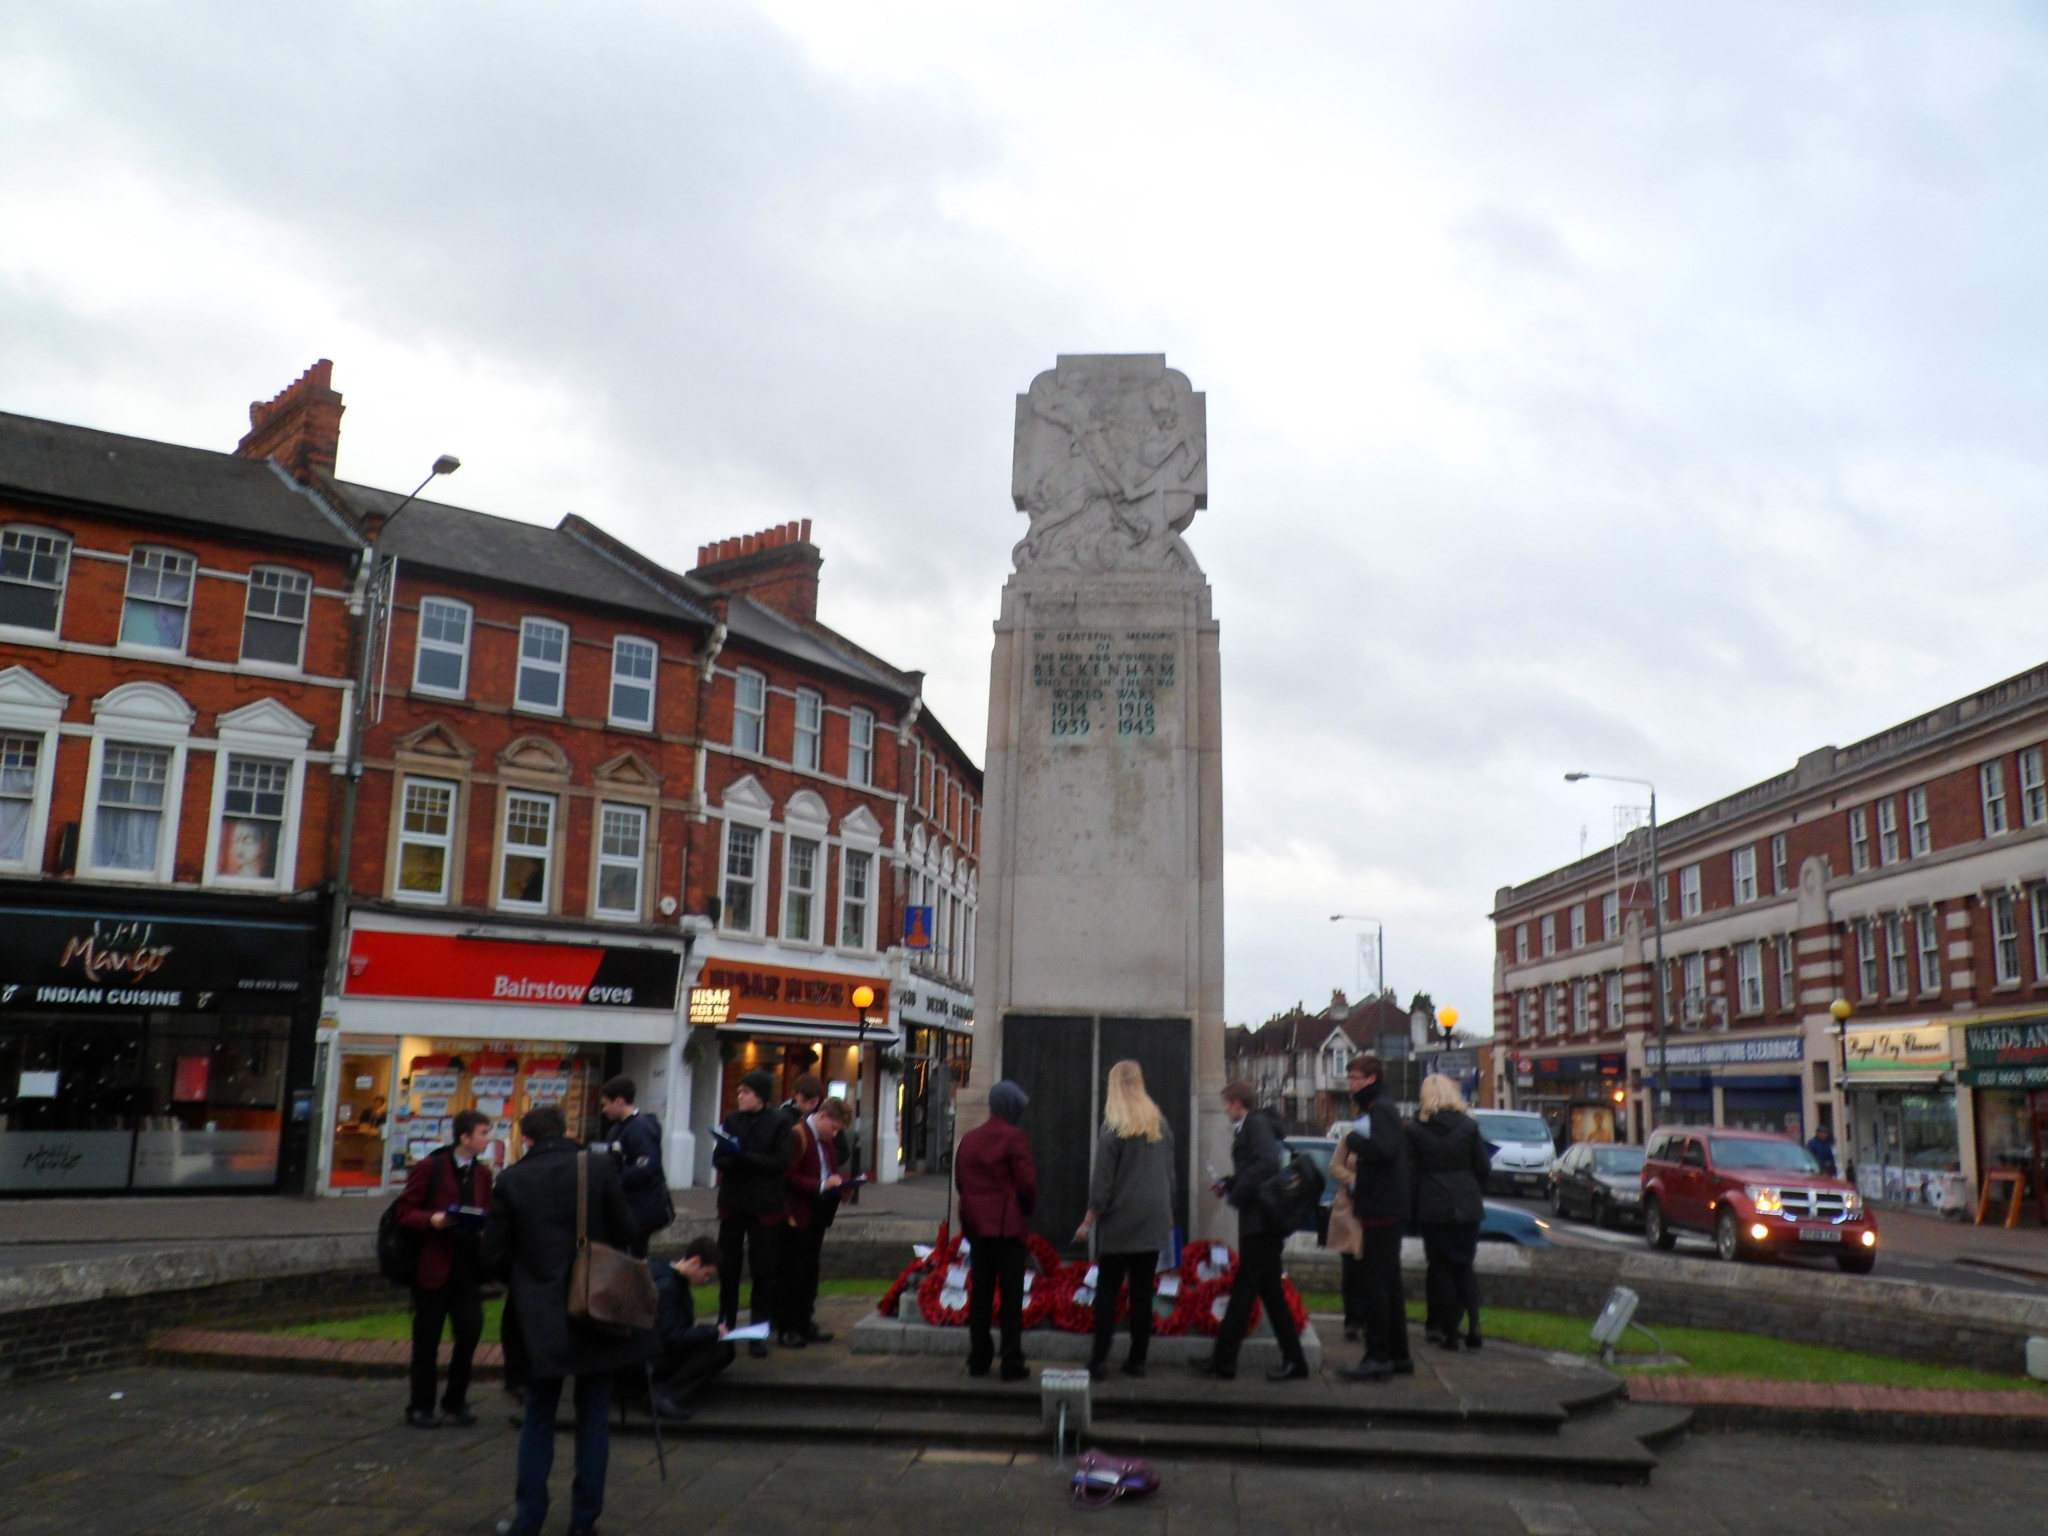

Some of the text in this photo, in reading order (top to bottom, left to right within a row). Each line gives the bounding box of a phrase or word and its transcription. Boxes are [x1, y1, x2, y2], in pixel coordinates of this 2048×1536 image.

[1126, 632, 1174, 641] MEMORY
[1034, 663, 1175, 677] BECKENHAM
[1053, 689, 1155, 700] WORLD WARS
[1051, 702, 1088, 717] 1914
[1118, 702, 1155, 718] 1918
[1051, 719, 1091, 735] 1939
[1118, 719, 1156, 735] 1945
[60, 935, 174, 984] Mango
[493, 975, 633, 1004] Bairstow eves
[709, 969, 781, 1000] HISAR
[36, 986, 181, 1006] INDIAN CUISINE
[691, 988, 731, 1005] HISAR
